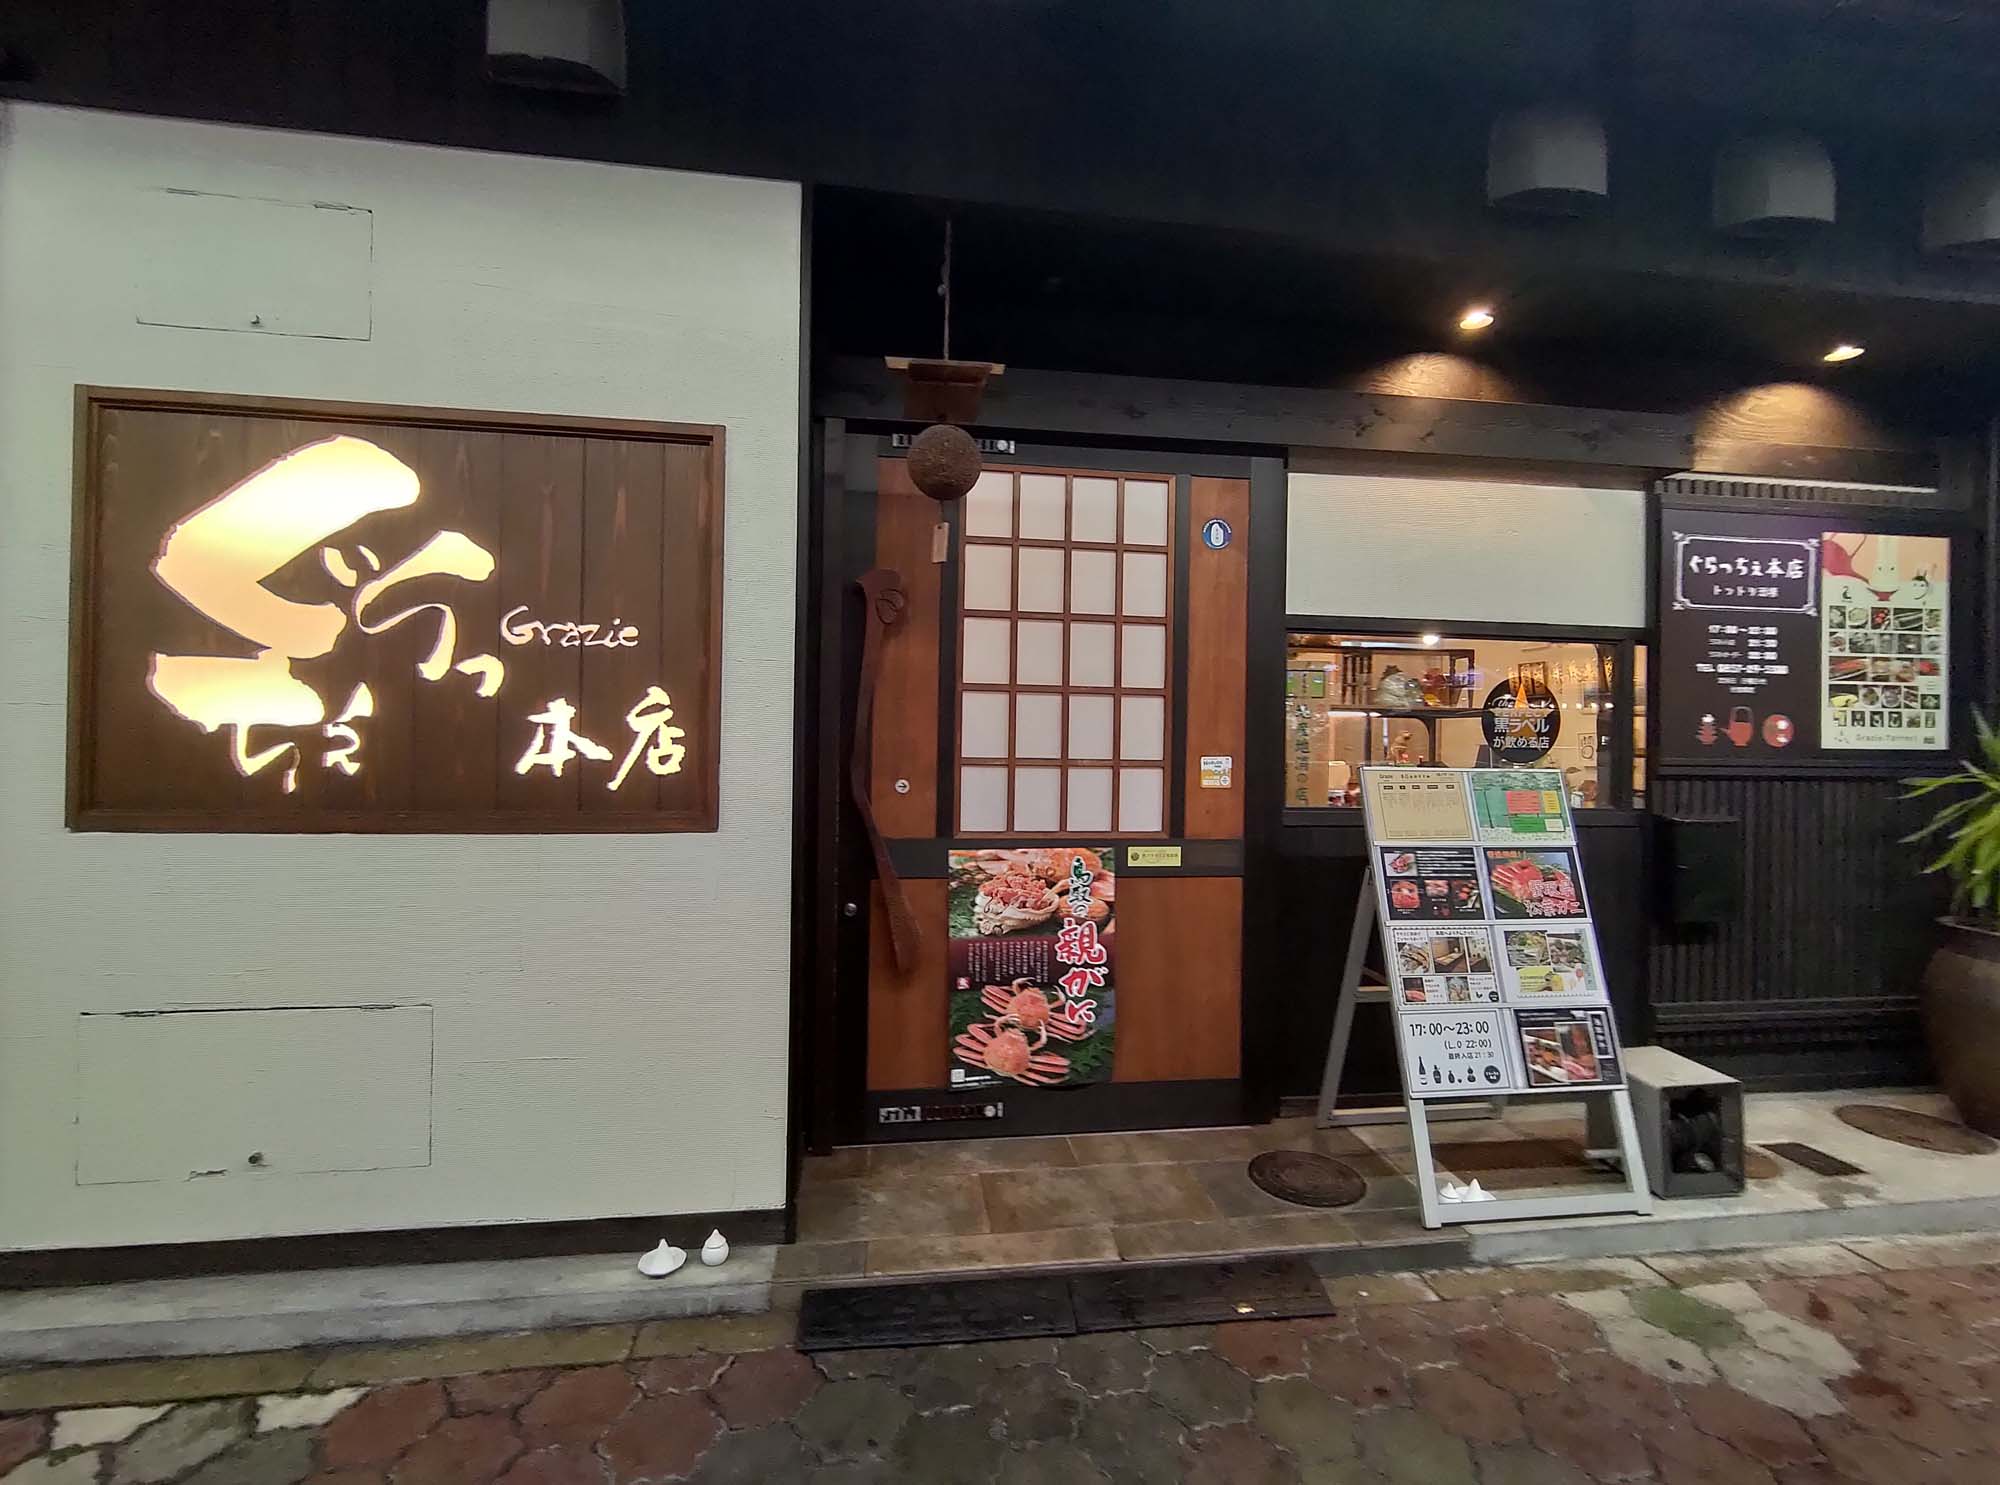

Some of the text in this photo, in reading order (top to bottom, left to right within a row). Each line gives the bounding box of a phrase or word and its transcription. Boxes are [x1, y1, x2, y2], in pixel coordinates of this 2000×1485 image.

[501, 604, 640, 648] Grazie
[515, 685, 687, 792] 本店
[1494, 718, 1550, 733] 黒ラベル
[1493, 736, 1550, 749] が飲める店
